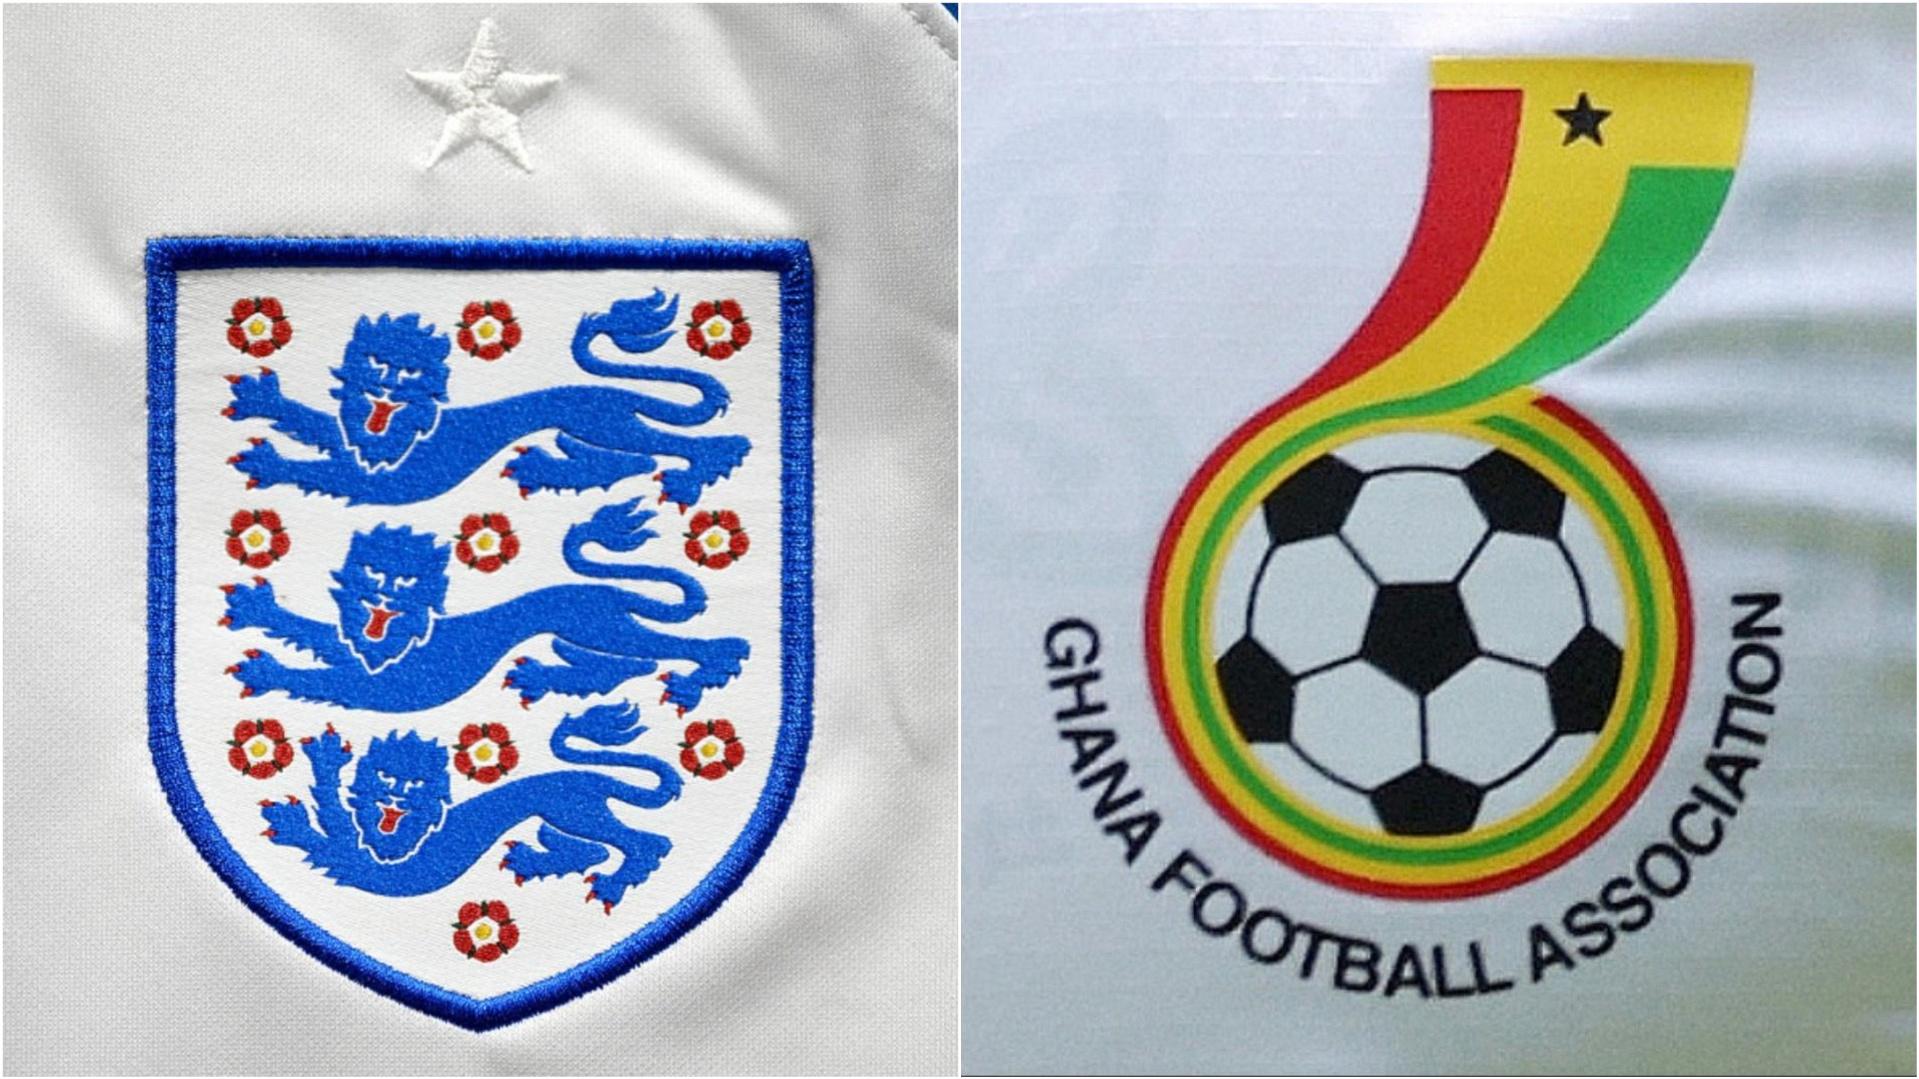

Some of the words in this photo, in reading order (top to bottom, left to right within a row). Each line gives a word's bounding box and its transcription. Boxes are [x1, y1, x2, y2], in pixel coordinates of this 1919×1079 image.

[1044, 618, 1162, 866] GHANA
[1150, 849, 1515, 999] FOOTBALL
[1529, 592, 1783, 984] ASSOCIATION
